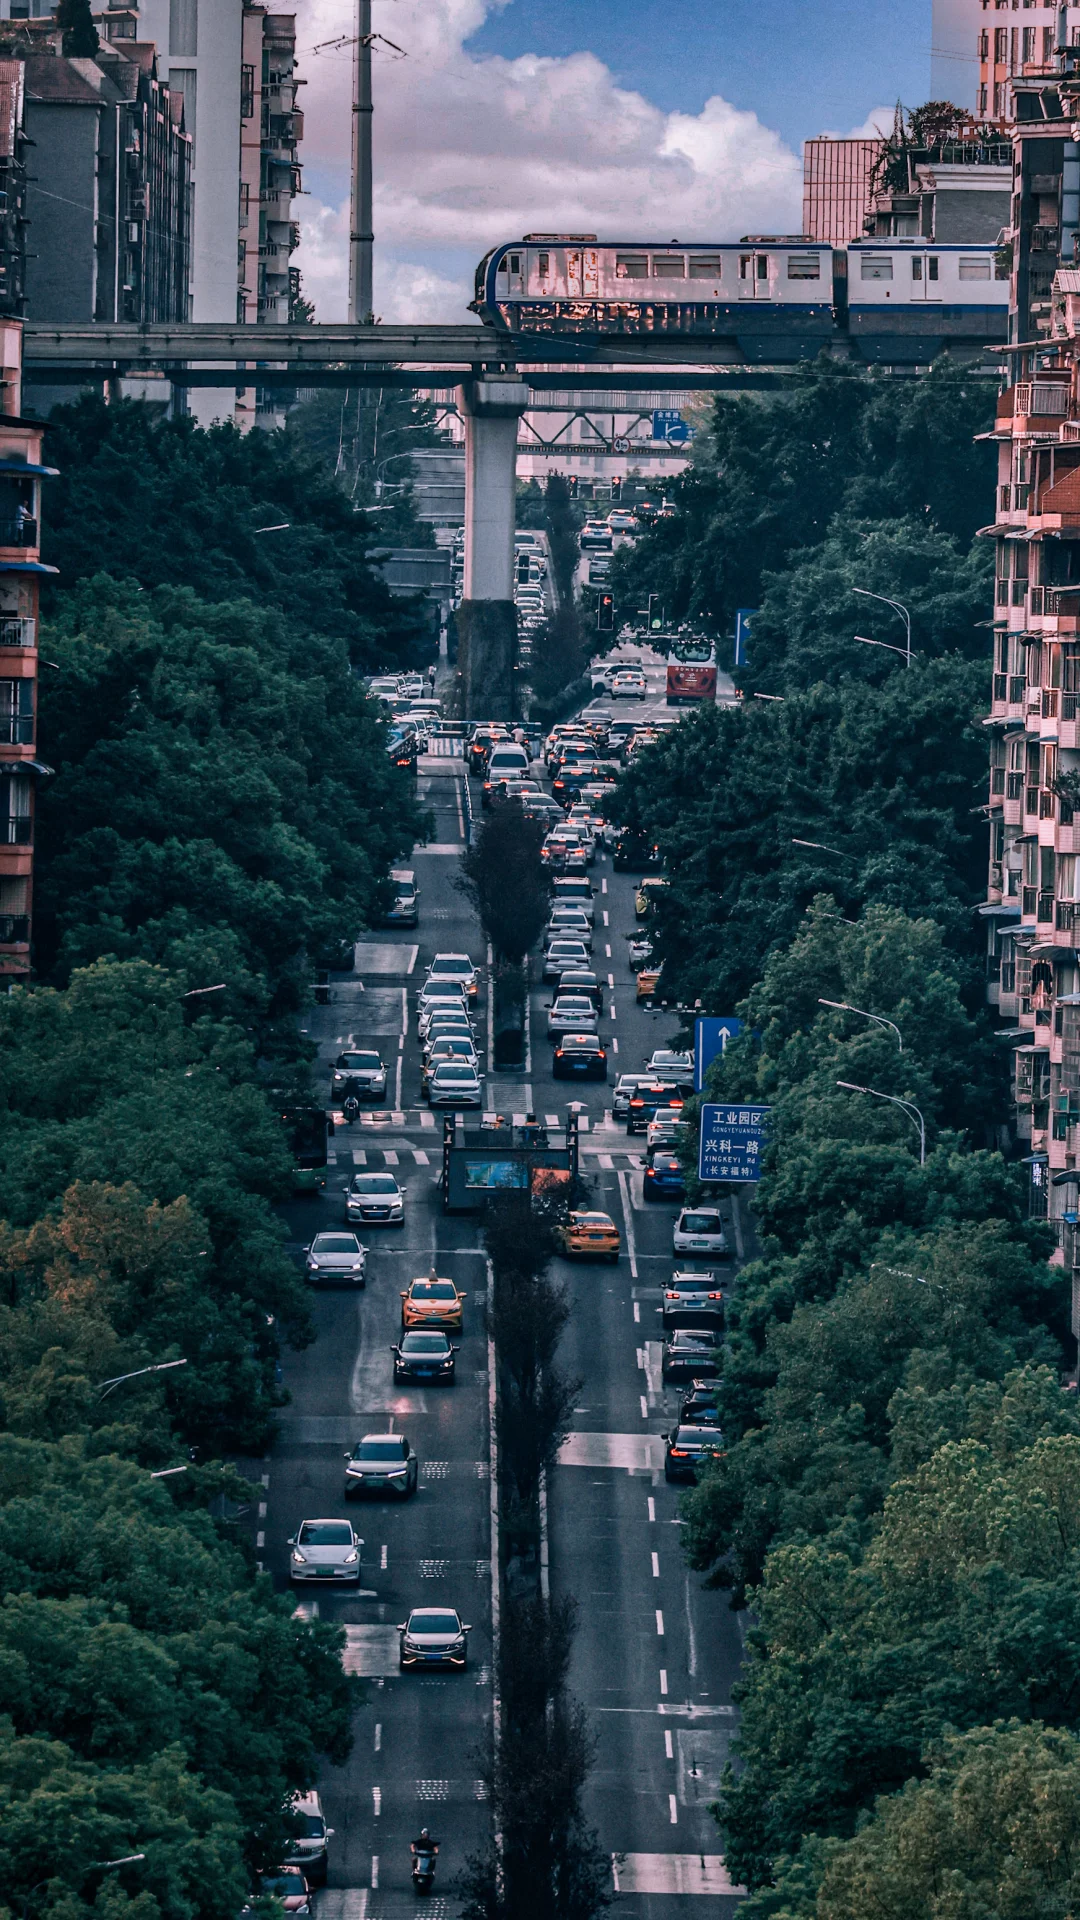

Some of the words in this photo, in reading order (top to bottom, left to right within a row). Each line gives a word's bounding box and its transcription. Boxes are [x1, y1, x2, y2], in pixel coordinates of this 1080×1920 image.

[713, 1111, 761, 1125] 工业园区
[705, 1139, 759, 1154] 兴科一路
